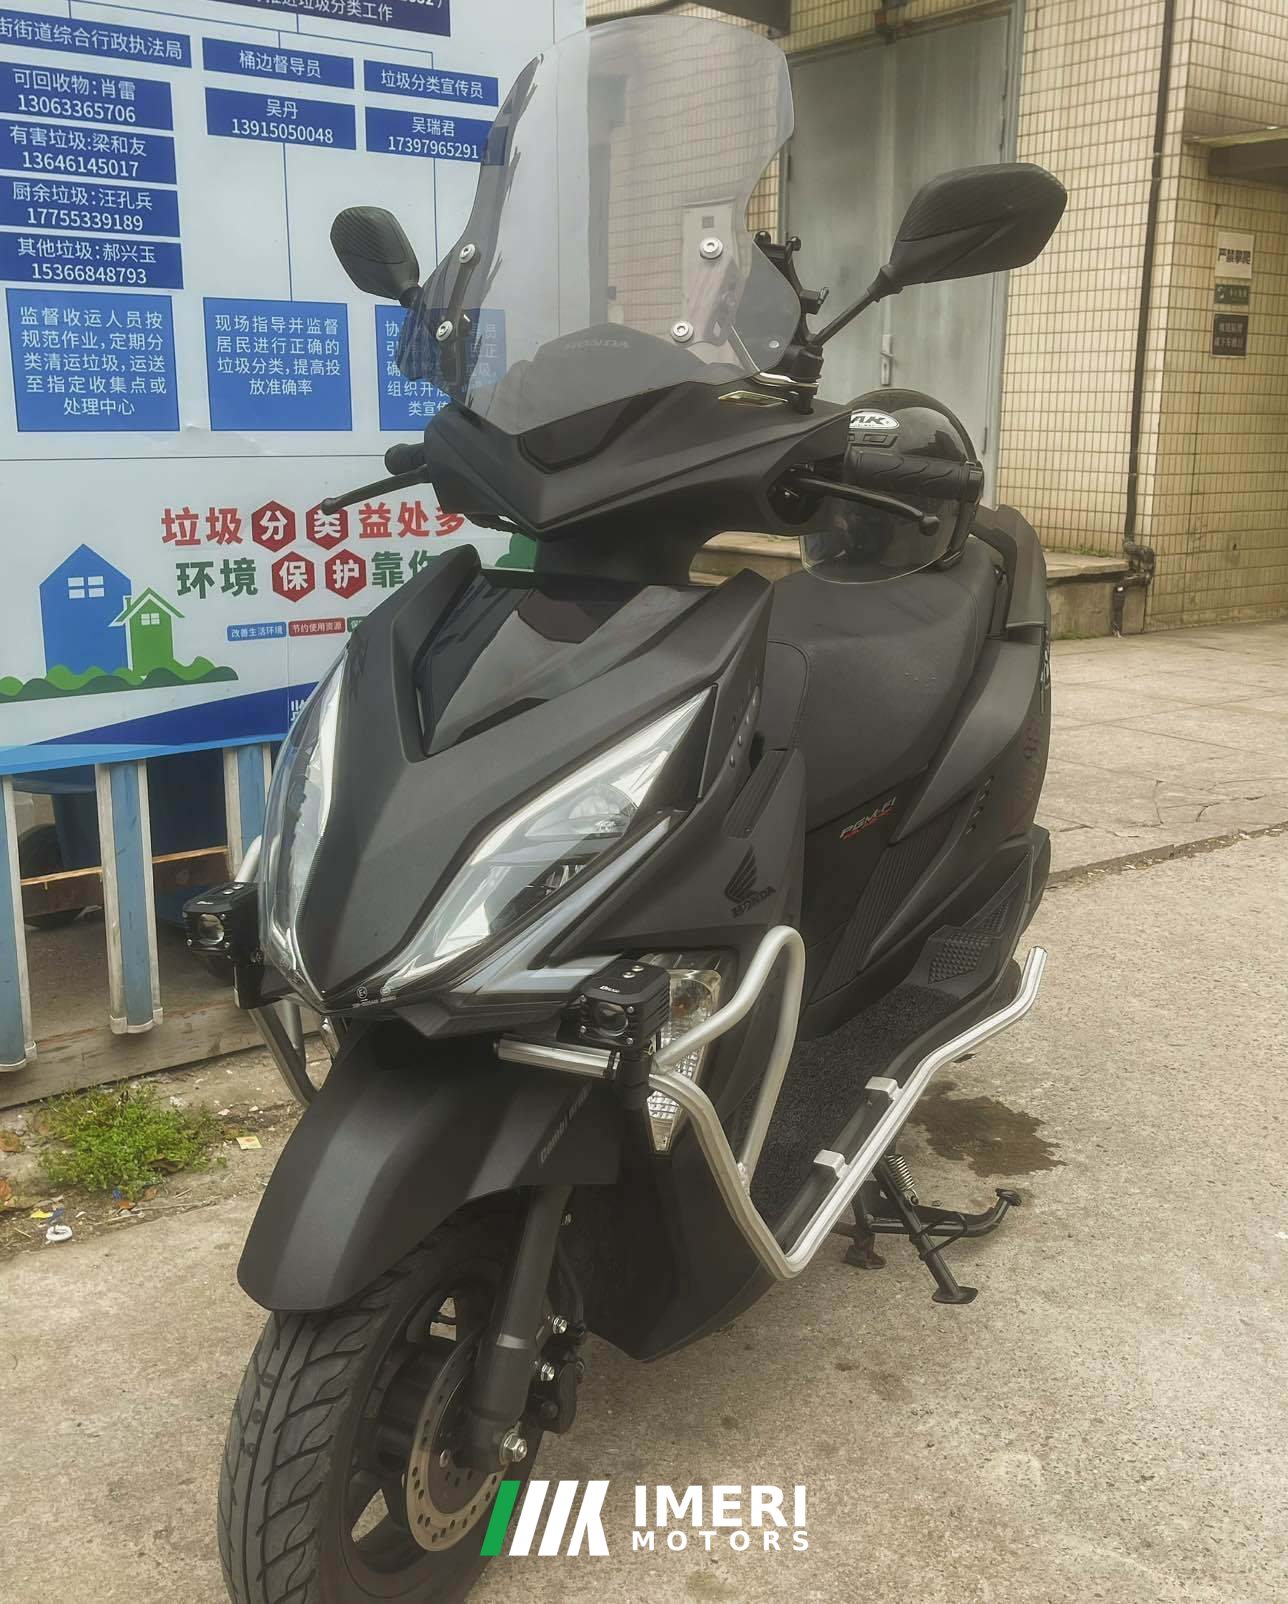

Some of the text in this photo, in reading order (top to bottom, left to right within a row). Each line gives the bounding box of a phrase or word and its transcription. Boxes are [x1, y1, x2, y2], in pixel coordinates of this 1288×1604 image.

[239, 49, 321, 79] 桶边督导员
[381, 69, 484, 99] 垃圾分类宣传员
[17, 94, 136, 123] 13063365706
[266, 98, 298, 120] 吴丹
[231, 118, 334, 144] 13915050048
[412, 116, 455, 137] 吴瑞君
[388, 136, 479, 159] 17397965291
[22, 152, 139, 177] 13646145017
[27, 207, 144, 231] 17755339189
[31, 263, 147, 284] 15366848793
[20, 306, 162, 329] 监督收运人员按
[215, 314, 339, 335] 现场指导并监督
[216, 336, 340, 356] 居民进行正确的
[25, 375, 167, 394] 至指定收集点或
[248, 378, 313, 396] 放准确率
[63, 397, 135, 416] 处理中心
